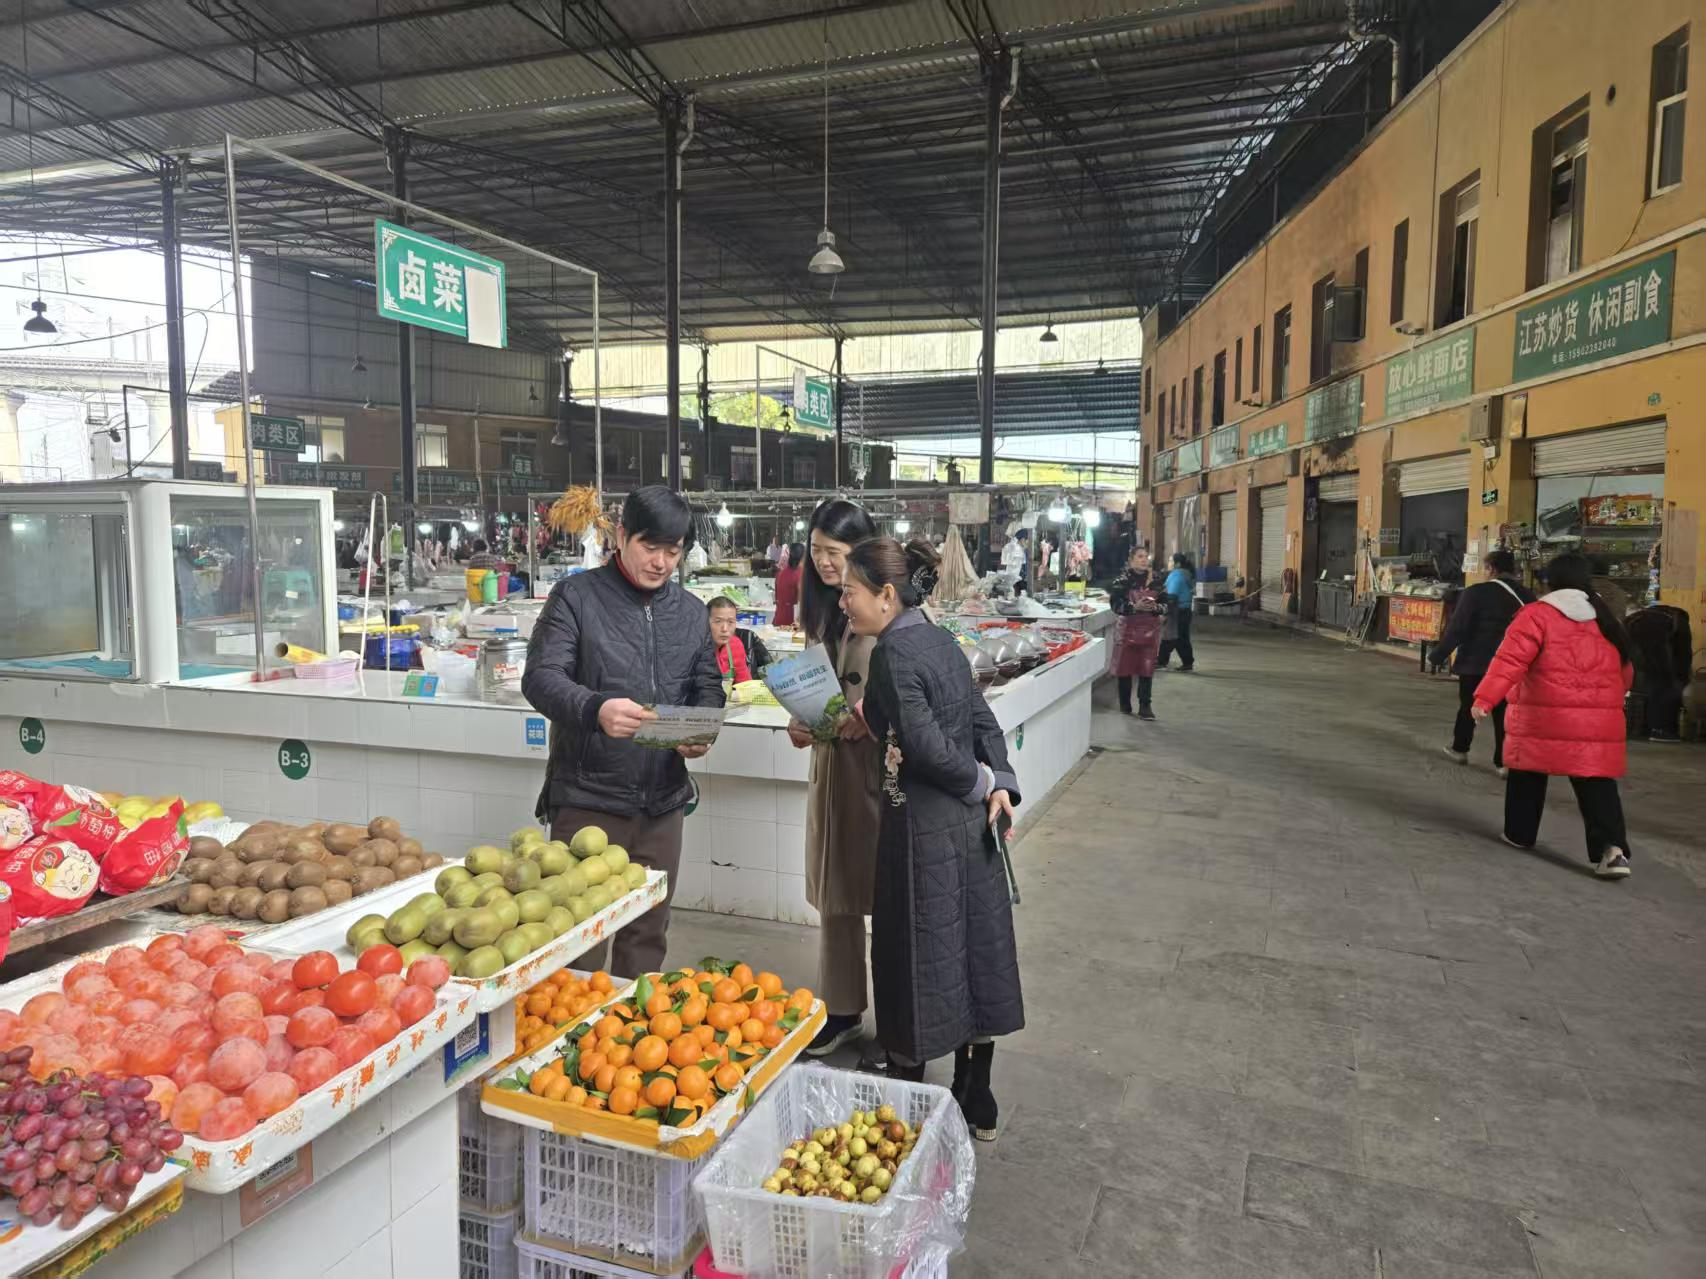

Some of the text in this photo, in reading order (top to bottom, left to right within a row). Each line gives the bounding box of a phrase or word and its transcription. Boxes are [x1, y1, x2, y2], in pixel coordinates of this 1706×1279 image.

[398, 249, 463, 313] 卤菜
[1519, 269, 1662, 357] 江苏炒货 休闲副食
[1388, 338, 1469, 395] 放心鲜面店
[251, 420, 300, 446] 肉类区
[21, 727, 44, 744] B-4
[281, 750, 309, 768] B-3
